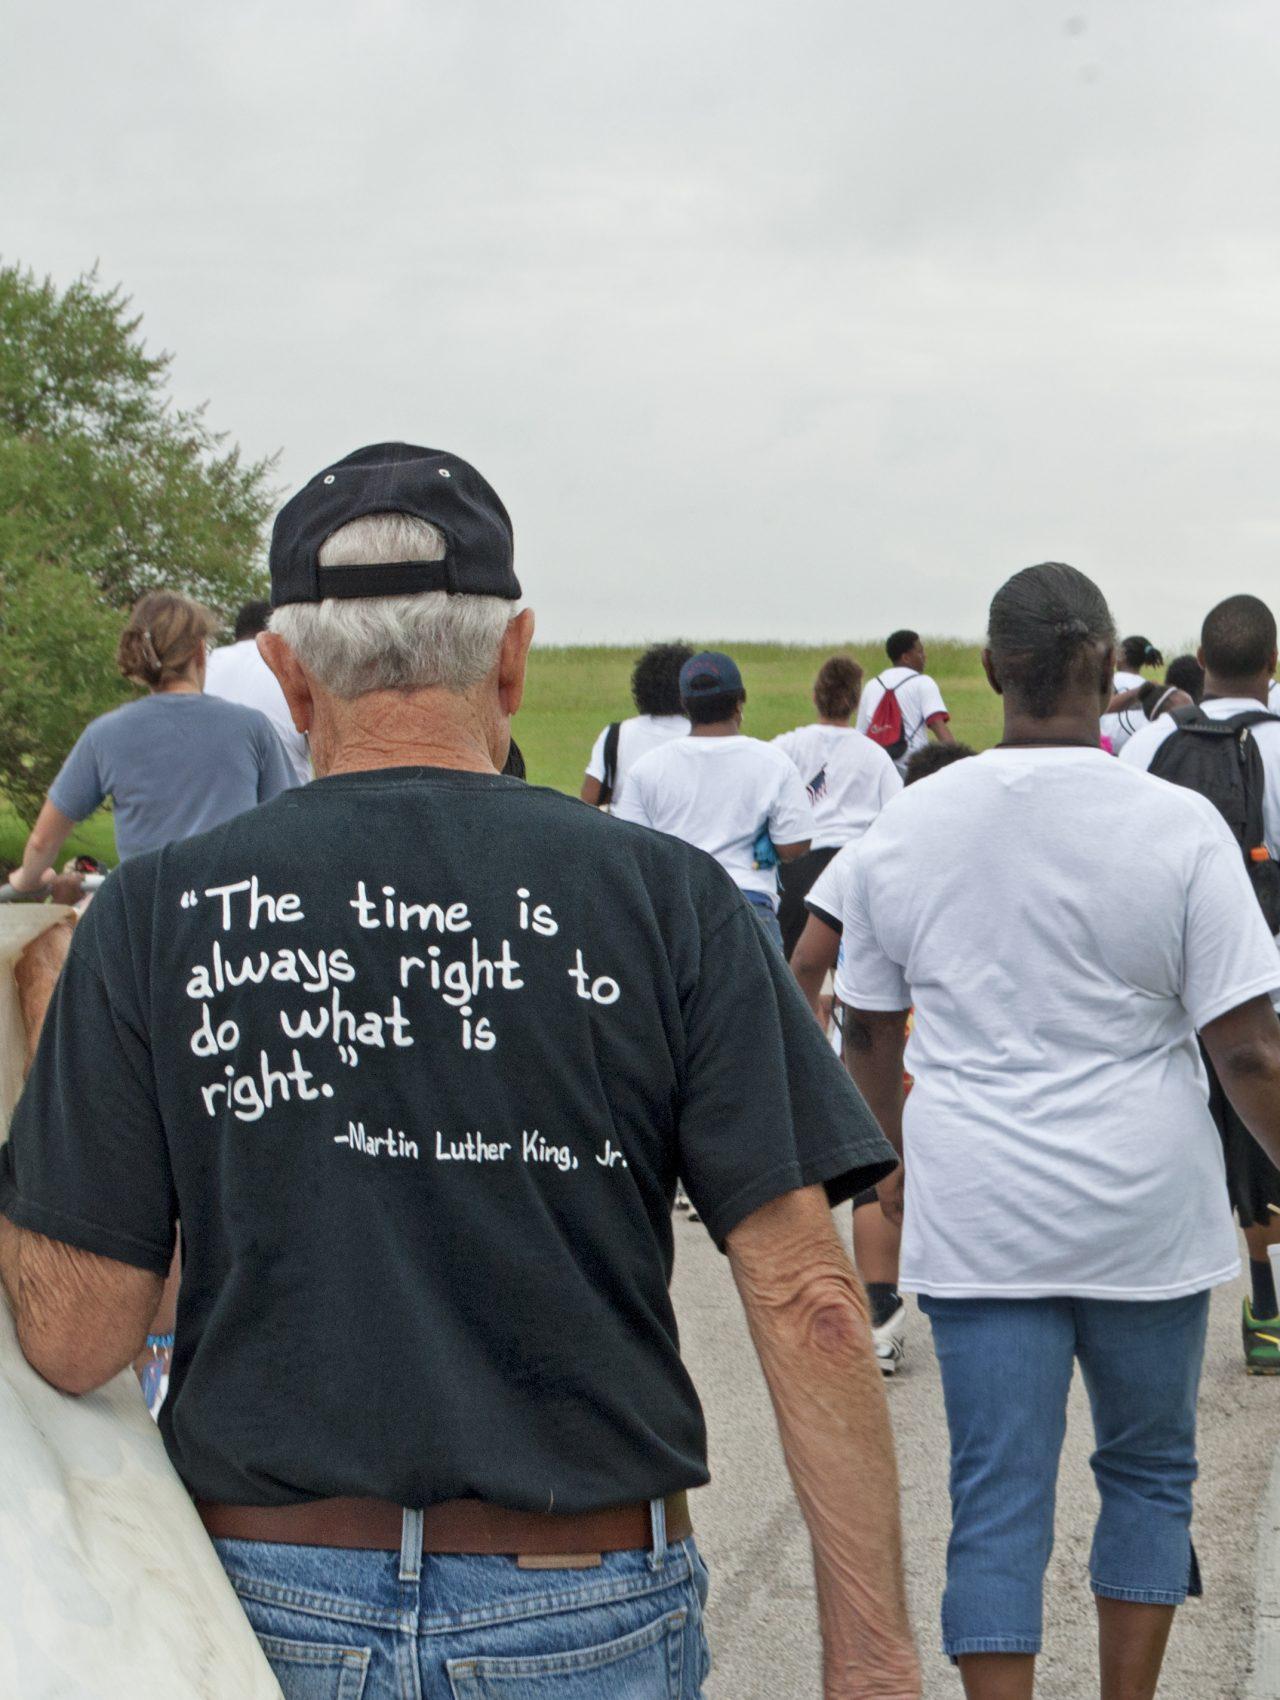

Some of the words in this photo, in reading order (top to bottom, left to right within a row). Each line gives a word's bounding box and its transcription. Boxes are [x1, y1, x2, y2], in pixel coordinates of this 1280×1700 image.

[349, 880, 472, 934] time
[516, 887, 559, 937] is
[185, 940, 356, 1000] always
[400, 937, 525, 1007] right
[567, 948, 621, 1006] to
[190, 1002, 240, 1057] do
[279, 986, 415, 1051] what
[459, 1005, 497, 1051] is
[435, 1130, 512, 1163] Luther
[522, 1129, 580, 1172] King,
[595, 1139, 629, 1169] Jr.
